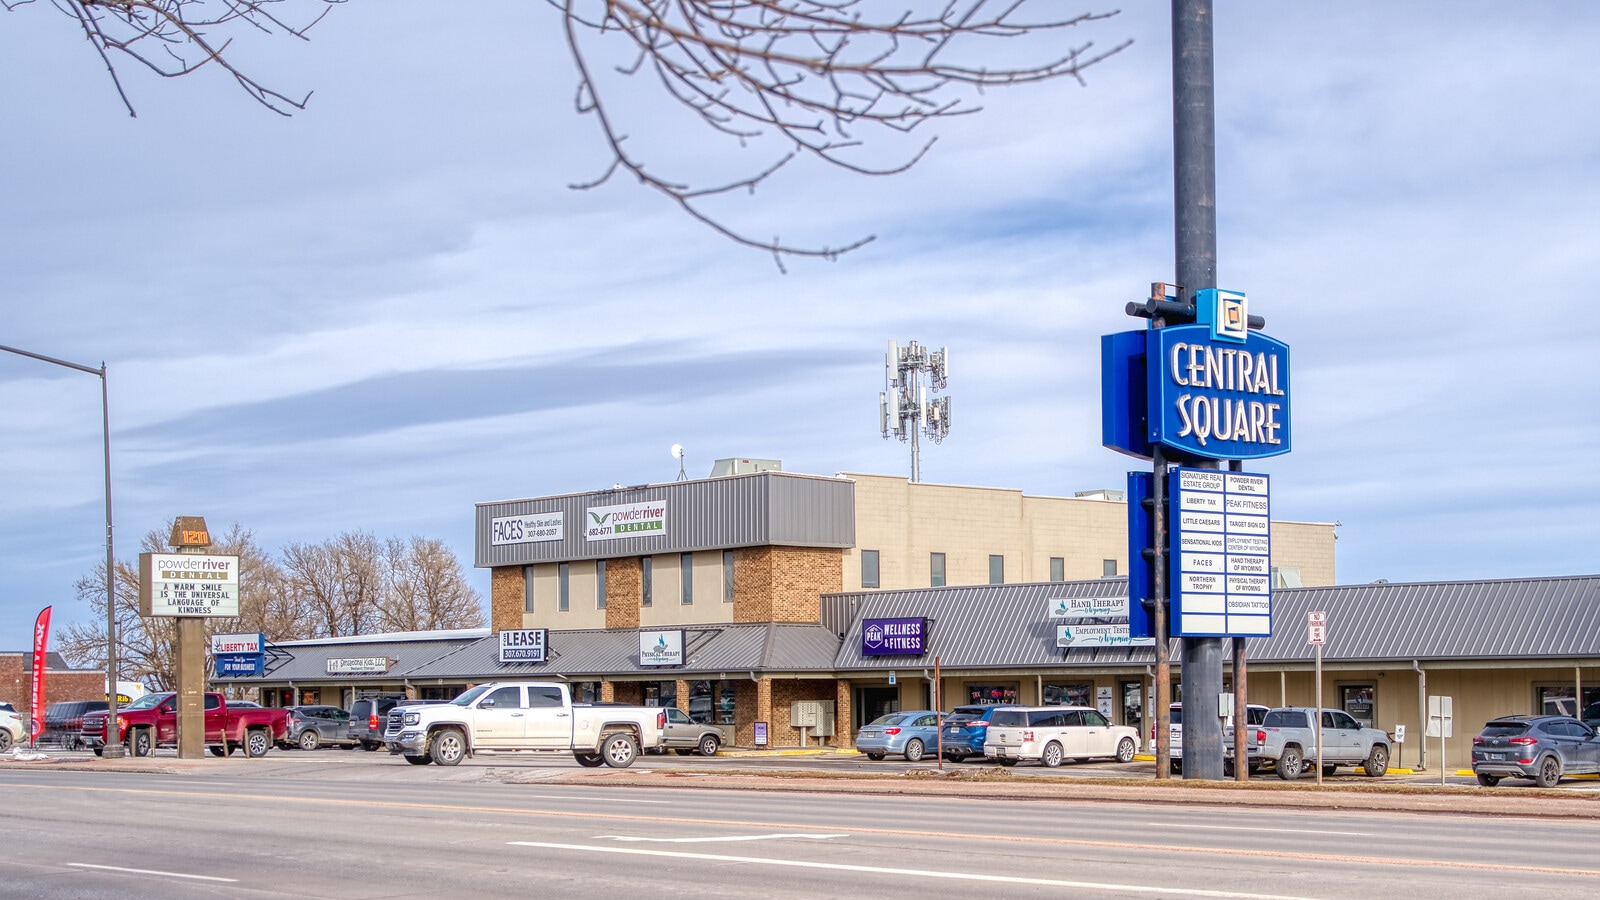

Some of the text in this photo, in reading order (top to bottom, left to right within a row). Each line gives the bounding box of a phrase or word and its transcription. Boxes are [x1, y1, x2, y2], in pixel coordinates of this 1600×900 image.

[1171, 341, 1284, 395] CENTRAL
[1176, 393, 1281, 446] SQUARE
[1181, 472, 1209, 481] SIGNATURE
[1226, 500, 1267, 510] PEAK FITNESS
[524, 521, 536, 529] Healthy
[620, 522, 658, 532] DENTAL
[494, 519, 522, 542] FACES
[528, 529, 557, 538] 307-680-2057
[588, 526, 612, 536] 682-6771
[182, 530, 208, 544] 1211
[1071, 598, 1124, 608] HAND THERAPY
[884, 624, 920, 635] WELLNESS
[1075, 626, 1130, 635] EMPLOYMENT TESTI
[507, 632, 541, 646] LEASE
[867, 632, 881, 641] PEAK
[220, 642, 258, 652] LIBERTY TAX
[885, 638, 920, 649] & FITNESS
